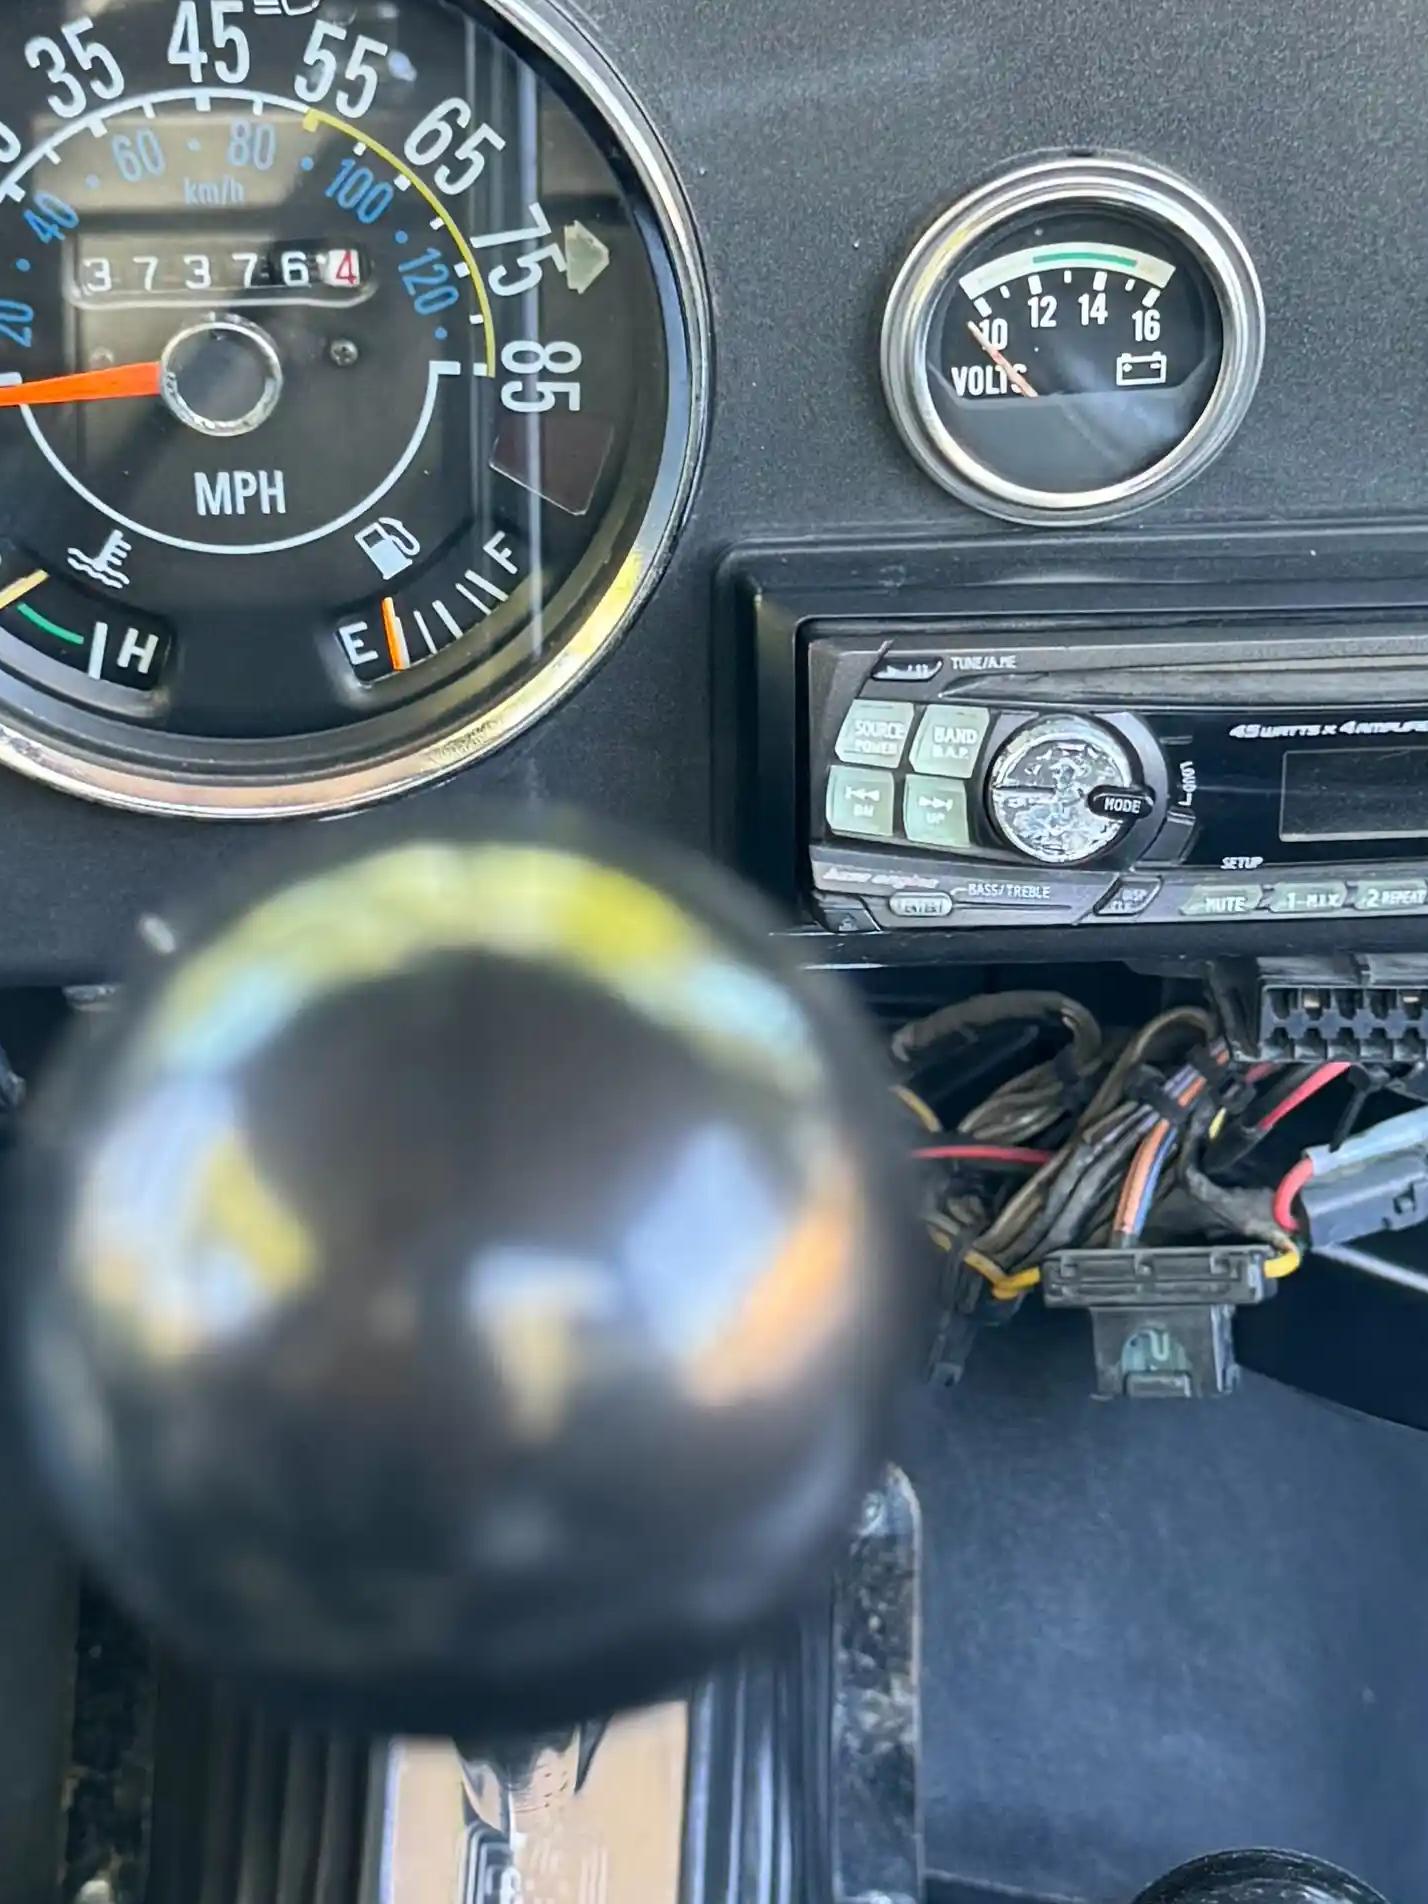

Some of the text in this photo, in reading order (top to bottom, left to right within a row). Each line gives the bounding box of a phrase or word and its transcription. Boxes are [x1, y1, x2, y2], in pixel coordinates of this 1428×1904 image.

[24, 16, 125, 118] 35
[294, 19, 388, 119] 55
[111, 128, 166, 182] 60
[227, 120, 275, 170] 80
[404, 97, 506, 195] 65
[183, 177, 246, 206] km/h
[325, 159, 394, 224] 100
[23, 191, 80, 244] 40
[470, 202, 568, 296] 75
[398, 247, 459, 315] 120
[1028, 295, 1057, 328] 12
[1078, 292, 1108, 326] 14
[1132, 309, 1161, 341] 16
[977, 318, 1008, 351] 10
[500, 340, 582, 413] 85
[194, 469, 286, 516] MPH
[483, 530, 518, 574] F
[117, 627, 159, 674] H
[338, 620, 379, 665] E
[855, 720, 905, 740] SOURCE
[933, 726, 978, 745] BAND
[1104, 797, 1142, 814] MODE
[1221, 857, 1264, 870] SETUP
[1205, 897, 1247, 912] MUTE
